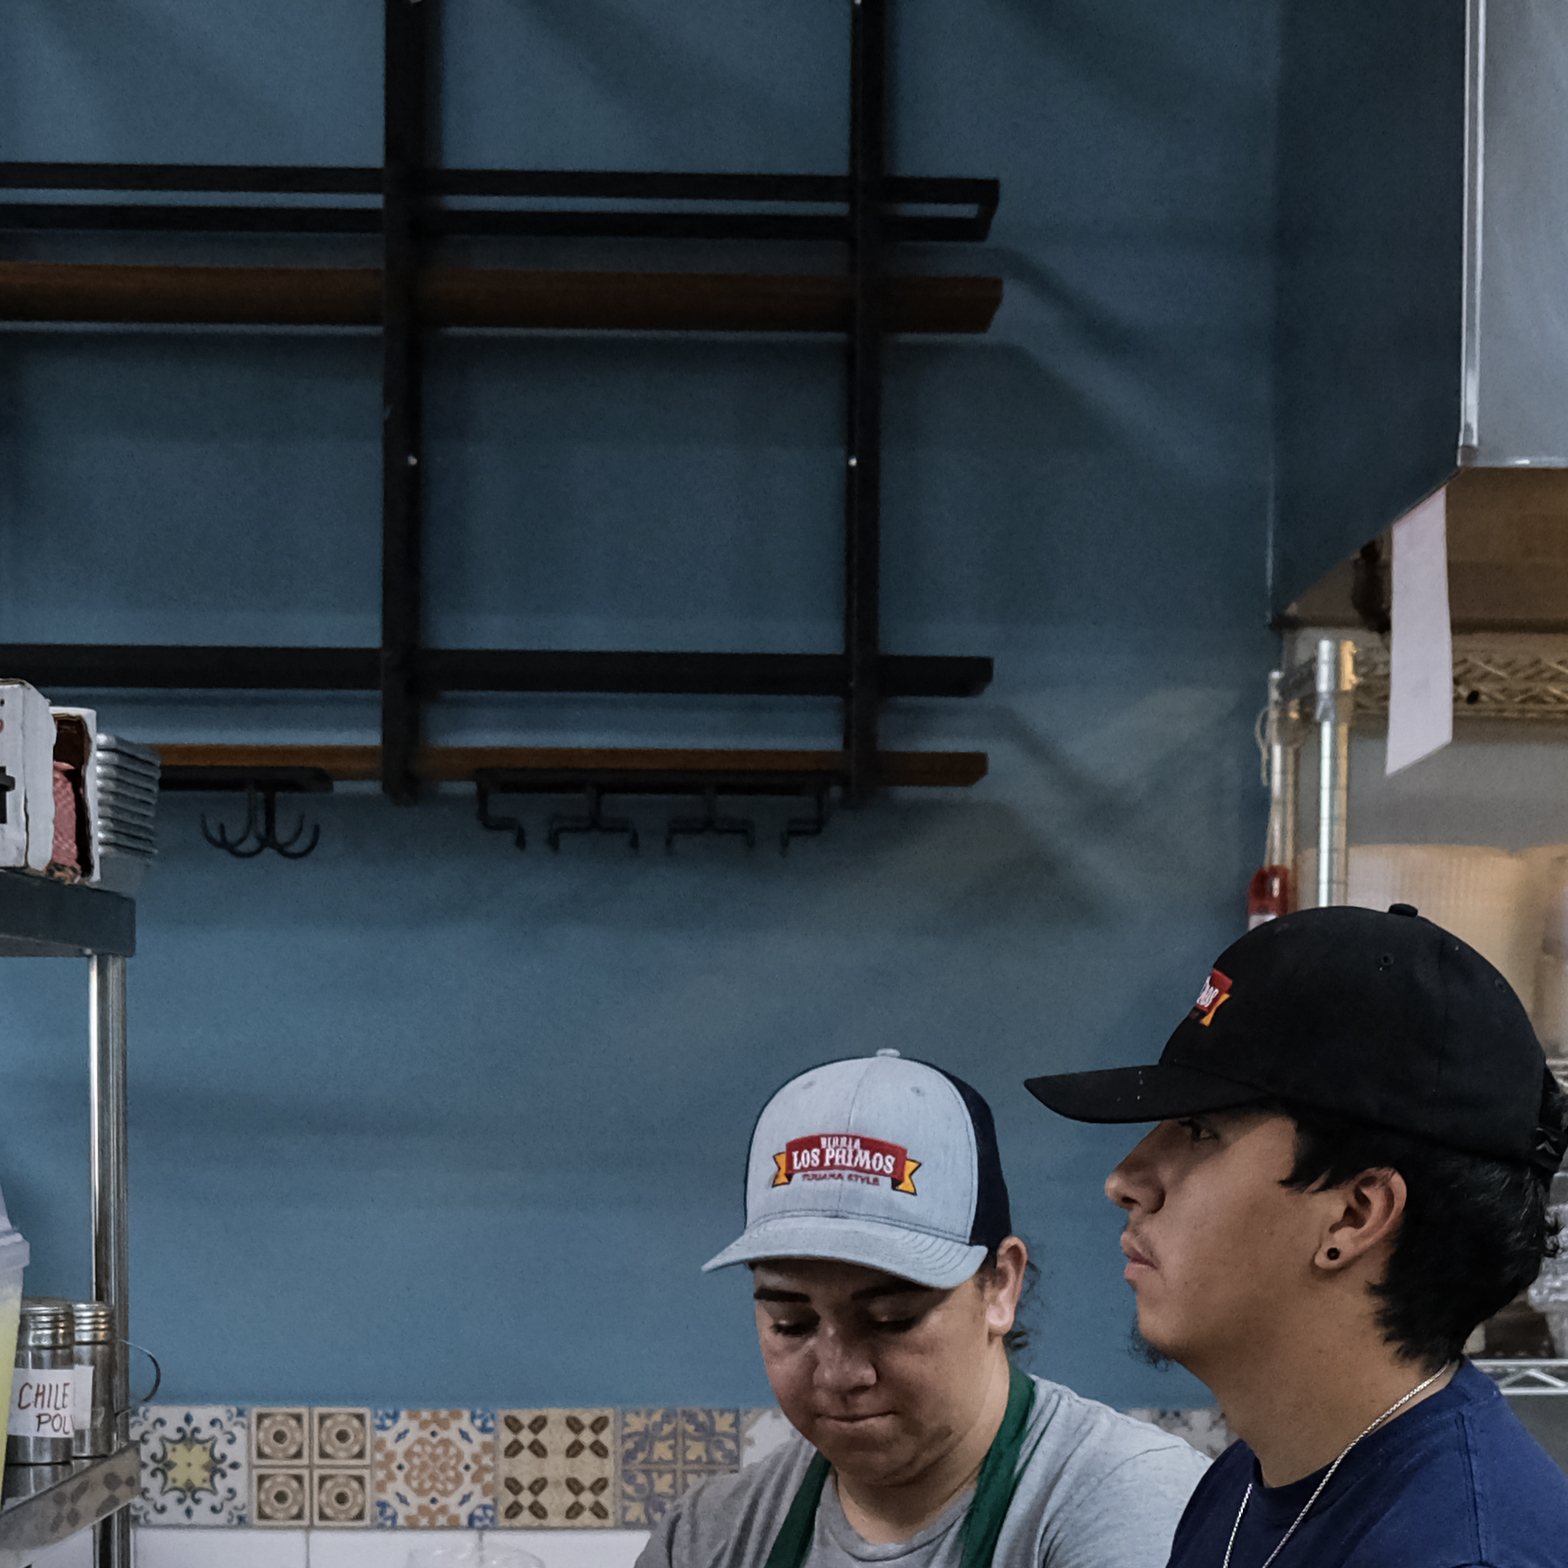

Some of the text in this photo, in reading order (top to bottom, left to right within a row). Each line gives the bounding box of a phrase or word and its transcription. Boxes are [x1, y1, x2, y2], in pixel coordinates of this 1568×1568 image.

[792, 1147, 897, 1175] LOS PRIMOS
[17, 1381, 71, 1411] CHILE
